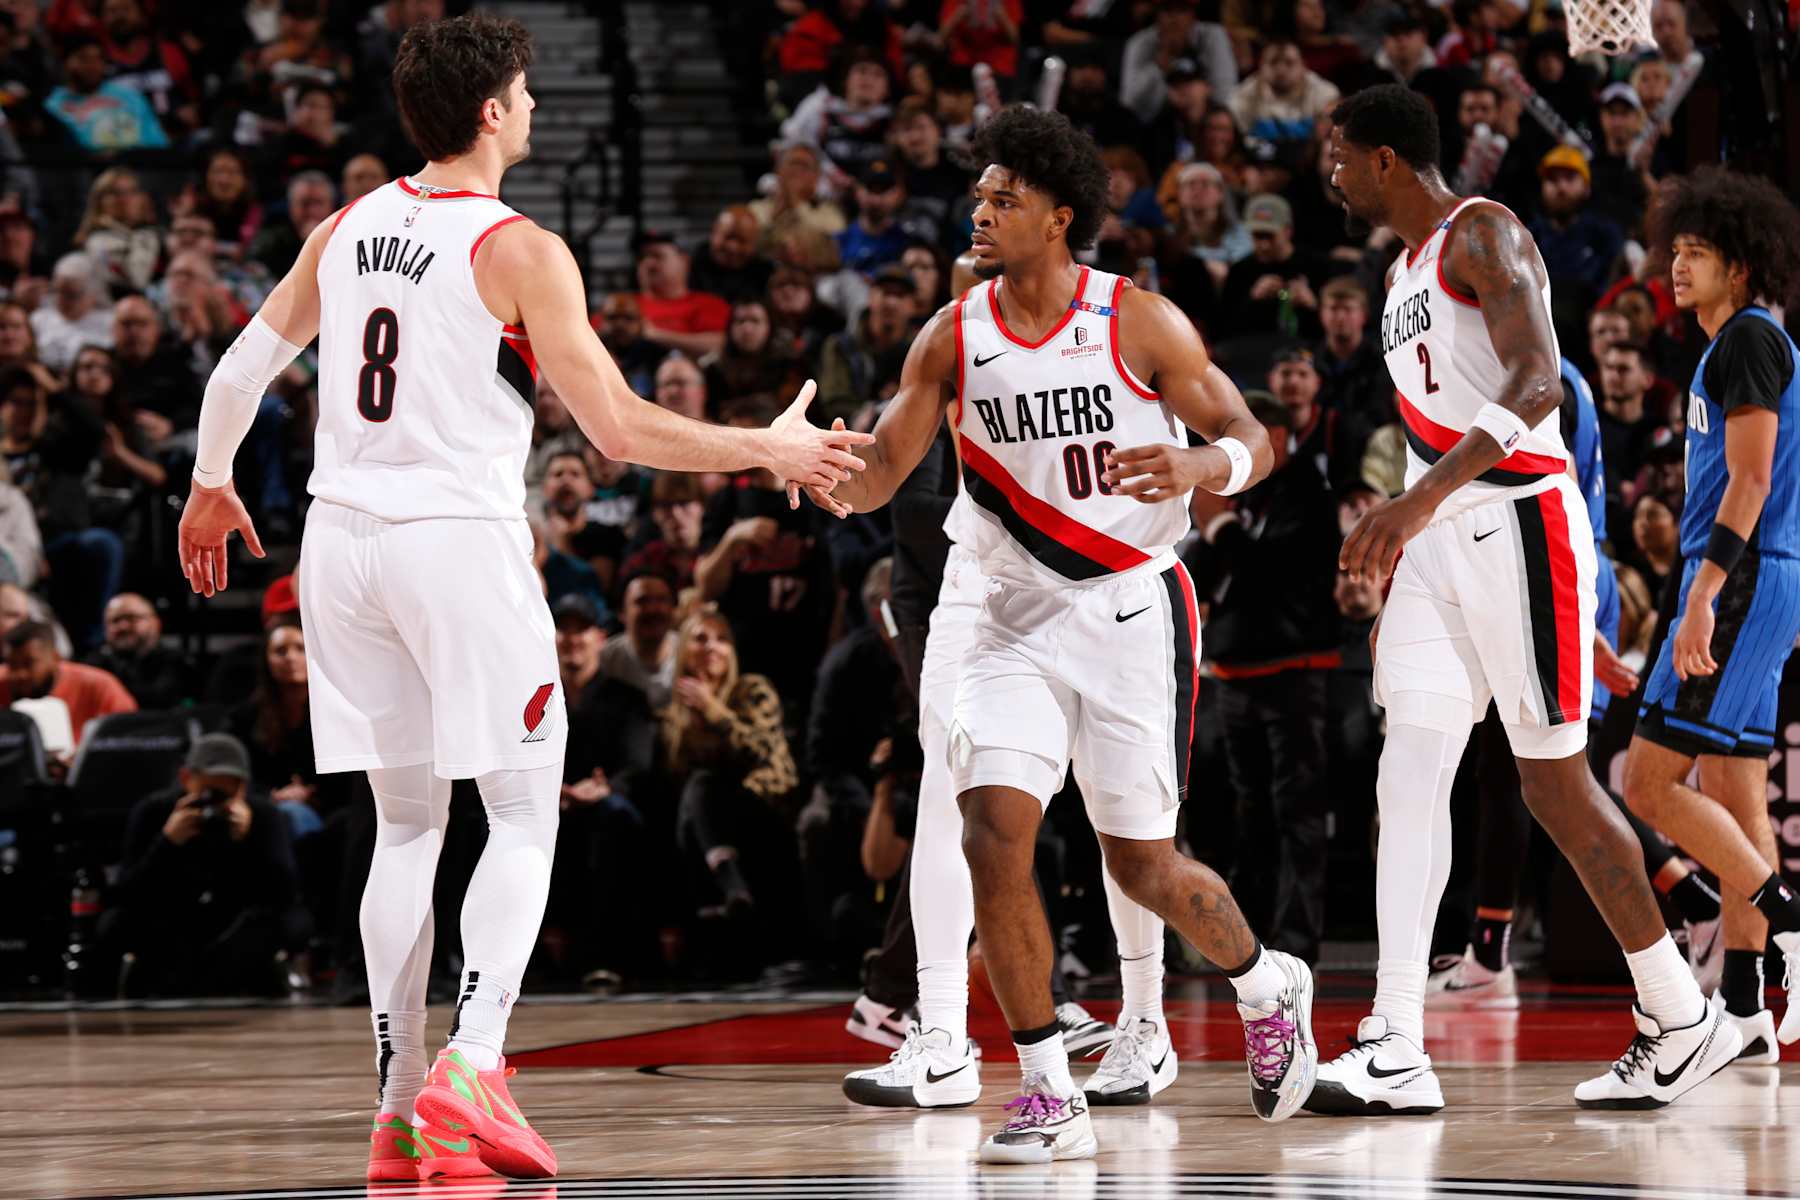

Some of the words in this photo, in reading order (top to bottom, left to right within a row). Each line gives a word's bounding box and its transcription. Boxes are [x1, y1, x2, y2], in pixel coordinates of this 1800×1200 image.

[357, 236, 435, 285] AVDIJA
[1061, 344, 1103, 357] BRIGHTSIDE
[1382, 288, 1431, 355] BLAZERS
[357, 307, 398, 422] 8
[1416, 342, 1440, 395] 2
[972, 384, 1114, 443] BLAZERS
[1062, 440, 1120, 500] 00
